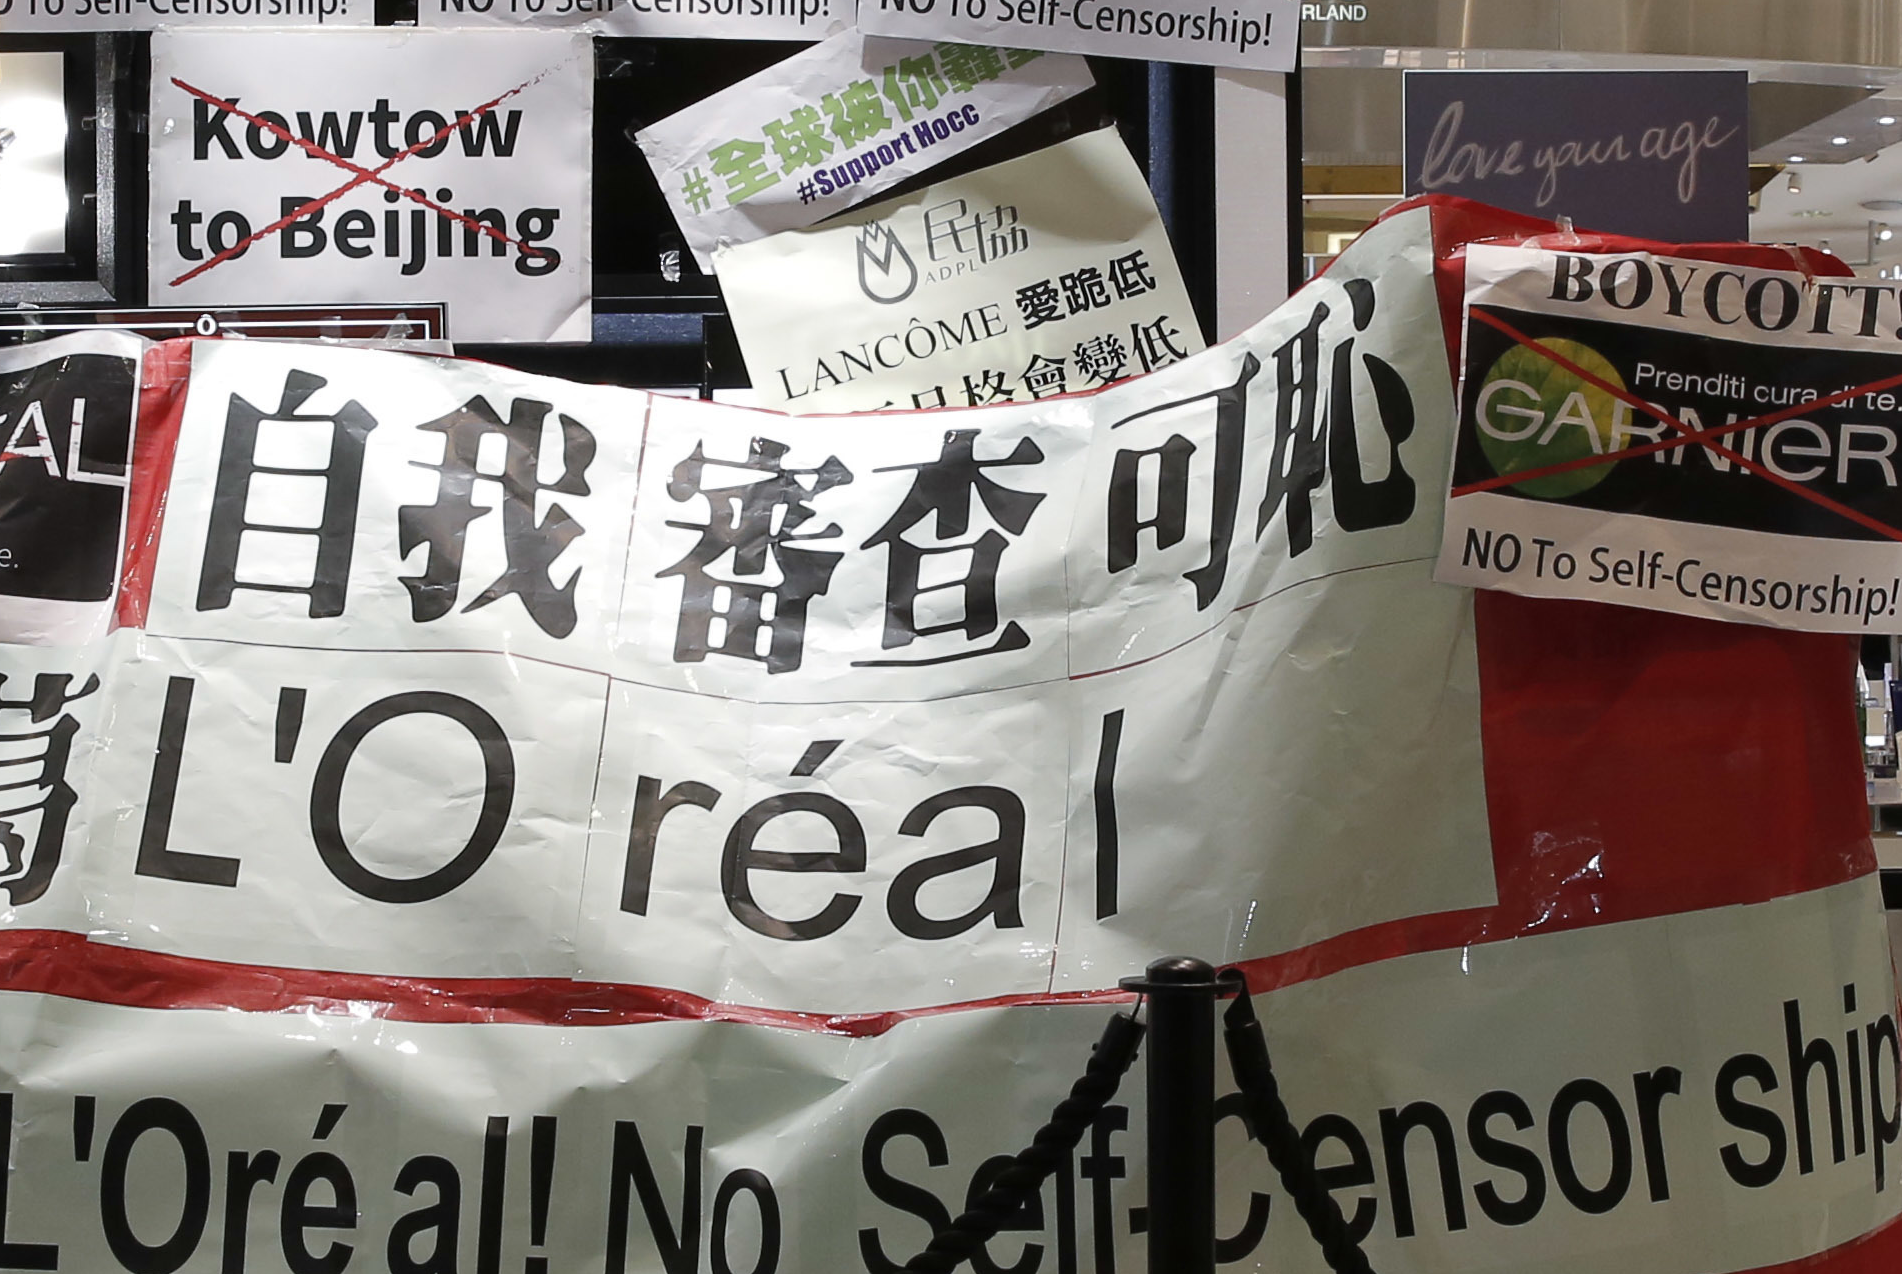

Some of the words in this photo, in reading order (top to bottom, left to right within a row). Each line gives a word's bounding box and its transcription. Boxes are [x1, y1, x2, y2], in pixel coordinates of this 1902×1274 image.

[193, 96, 523, 161] Kowtow
[171, 199, 253, 261] to
[279, 188, 561, 277] Beijing
[925, 261, 979, 285] ADPL
[775, 302, 1009, 401] LANCÔME
[1015, 249, 1158, 331] 愛跪低
[1635, 361, 1745, 400] Prenditi
[1753, 382, 1818, 407] cura
[1828, 385, 1855, 409] di
[1462, 528, 1522, 574] NO
[1533, 537, 1577, 580] To
[1589, 546, 1901, 625] Self-Censorship!
